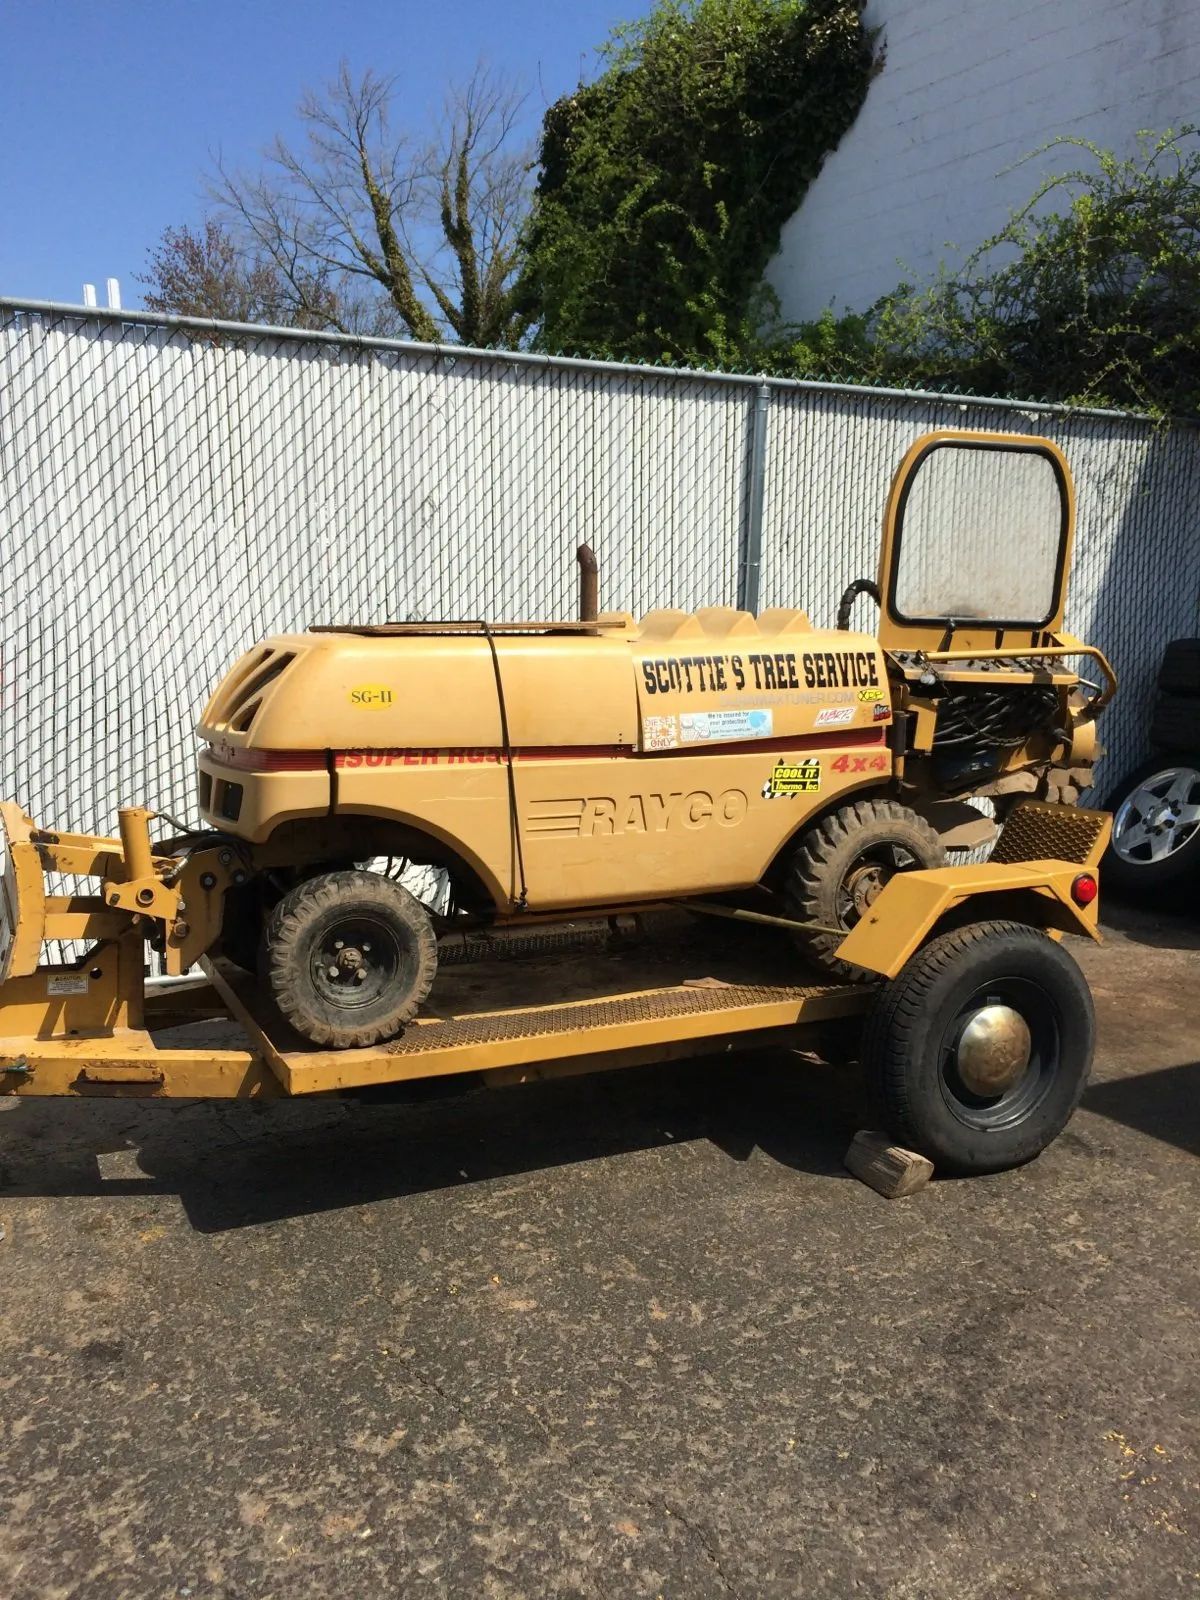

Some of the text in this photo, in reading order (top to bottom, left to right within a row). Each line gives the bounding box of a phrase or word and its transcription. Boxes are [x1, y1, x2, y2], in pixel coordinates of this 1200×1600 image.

[642, 652, 879, 694] SCOTTIE'S TREE SERVICE
[351, 690, 392, 704] SG-II
[644, 717, 676, 727] DIESEL
[650, 738, 675, 748] ONLY
[345, 748, 439, 768] SUPER
[775, 768, 804, 778] COOL
[776, 780, 818, 790] Thermo Tec
[578, 788, 748, 837] RAYCO
